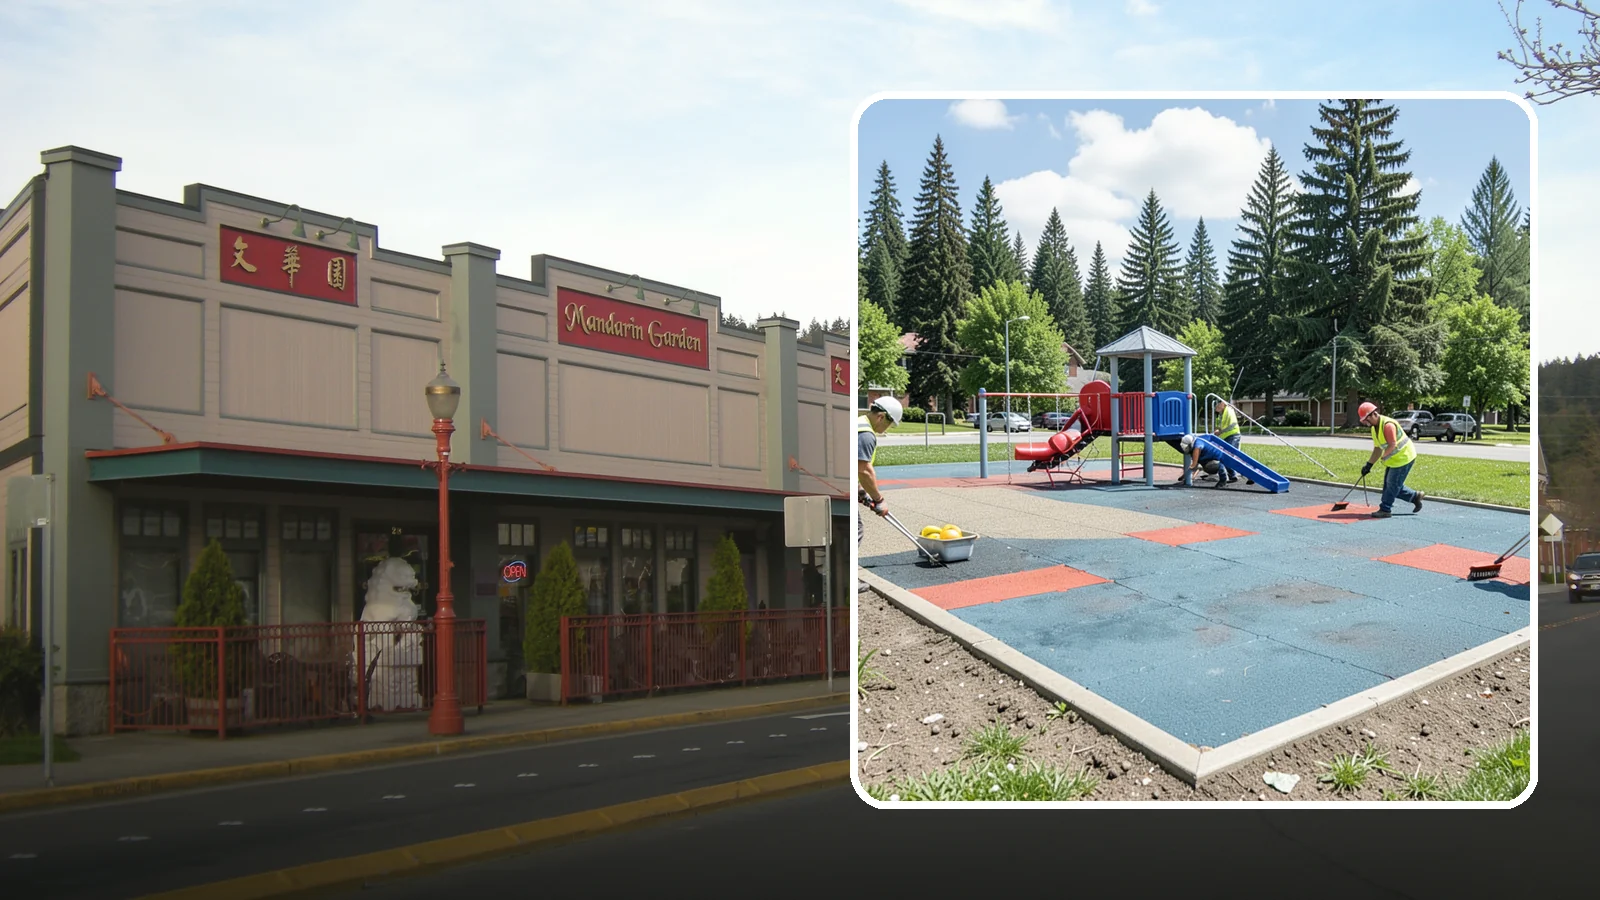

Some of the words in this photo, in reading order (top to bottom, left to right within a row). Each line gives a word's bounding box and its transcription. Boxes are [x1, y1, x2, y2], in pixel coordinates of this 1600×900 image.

[231, 236, 346, 290] 文華園
[565, 302, 644, 341] Mandarin
[648, 320, 701, 352] Garden
[503, 565, 527, 578] OPEN
